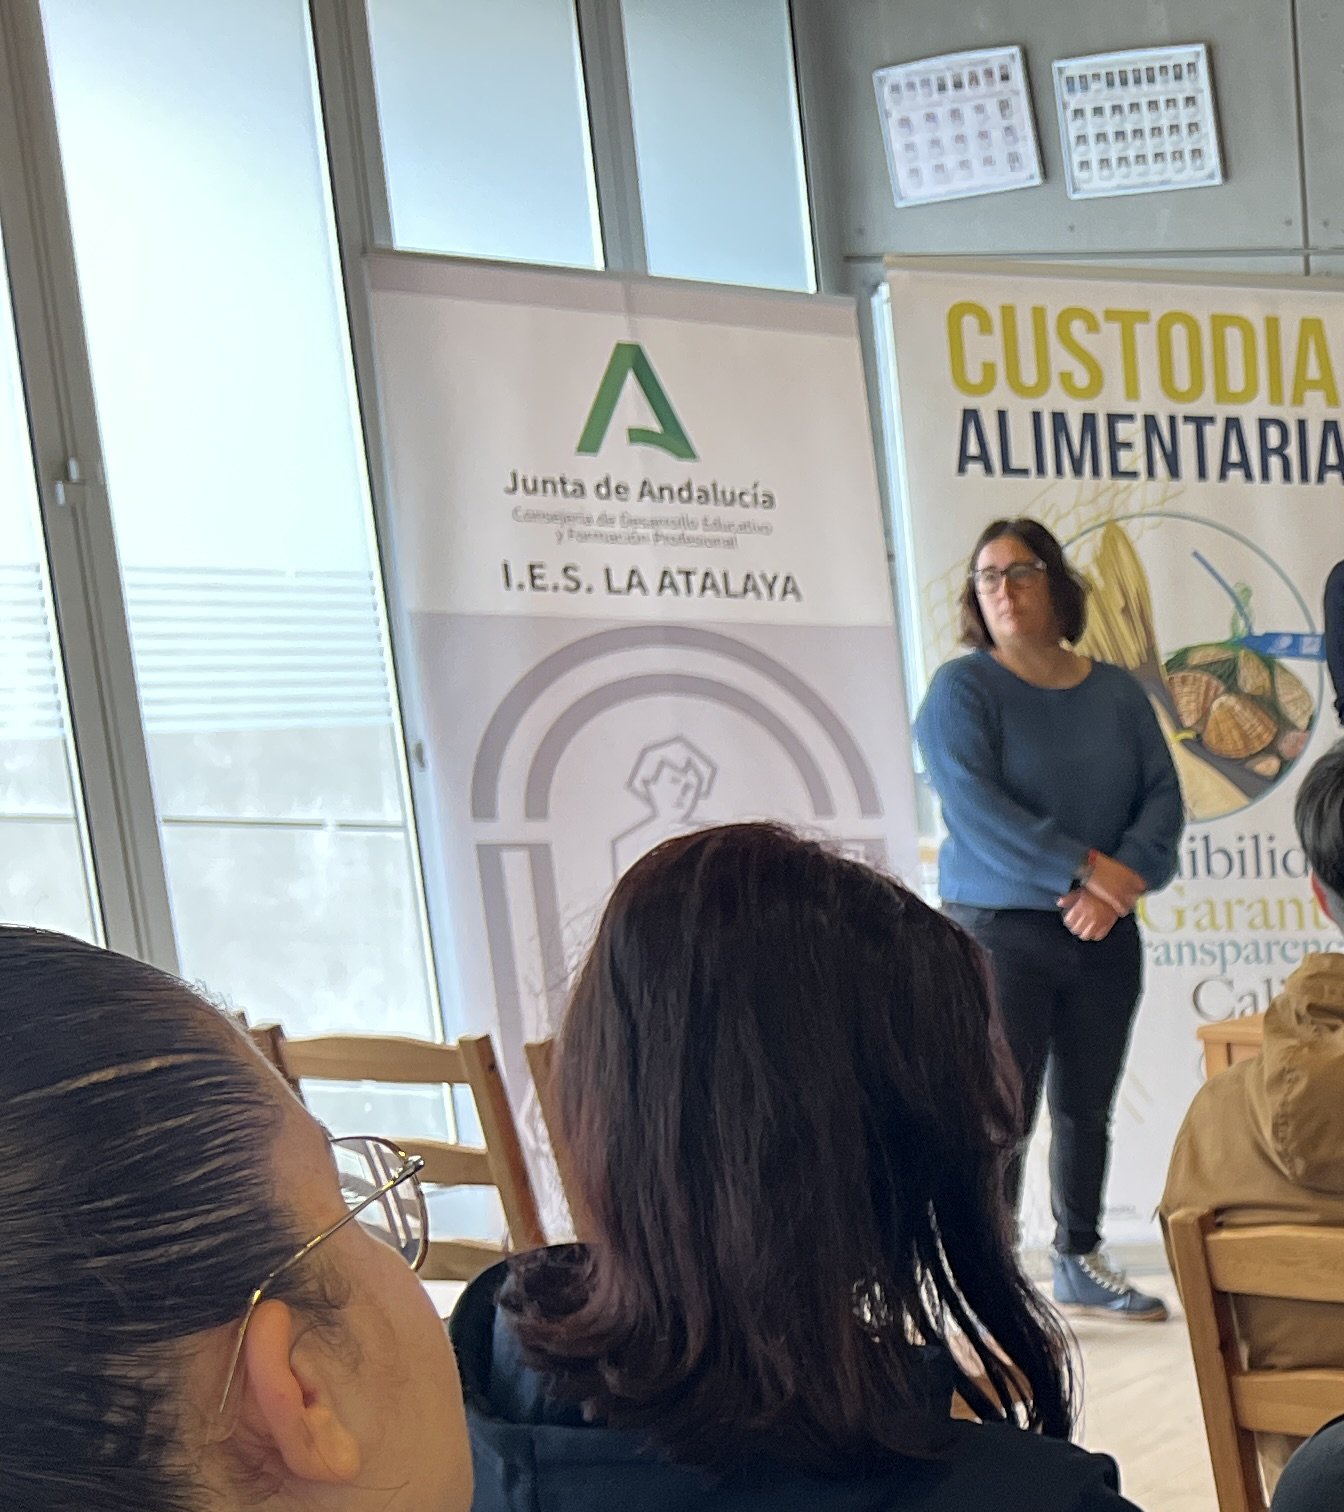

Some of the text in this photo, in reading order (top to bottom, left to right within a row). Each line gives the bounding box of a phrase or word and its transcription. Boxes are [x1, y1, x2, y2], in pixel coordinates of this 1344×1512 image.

[946, 302, 1341, 408] CUSTODIA
[504, 469, 776, 510] Junta de Andalucía
[503, 560, 802, 602] I.E.S. LA ATALAYA
